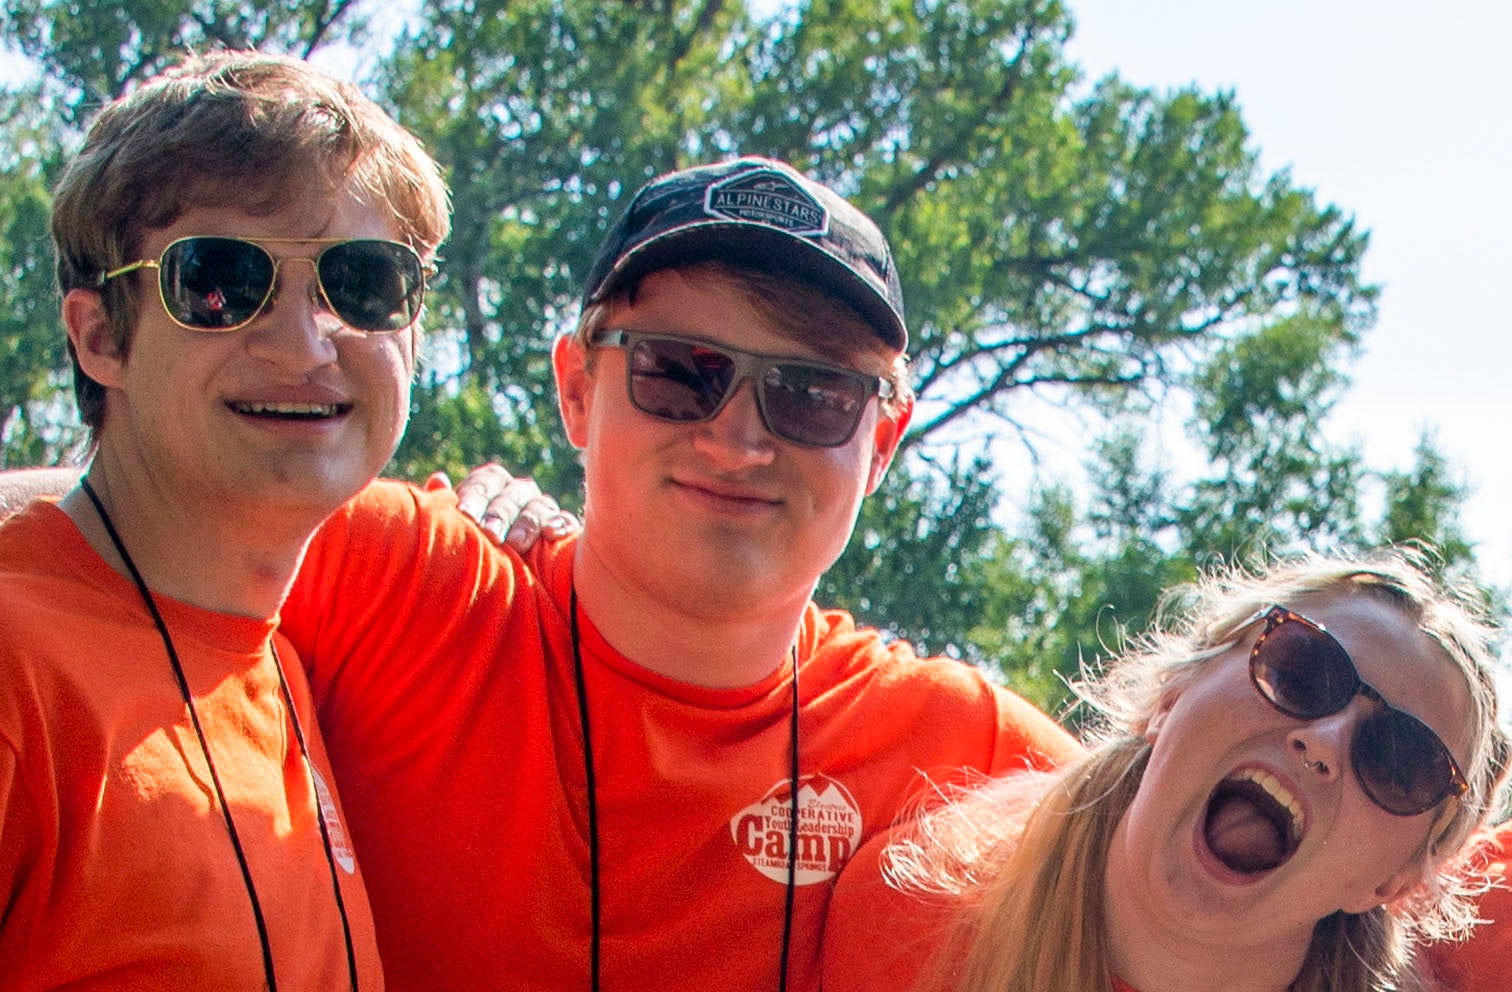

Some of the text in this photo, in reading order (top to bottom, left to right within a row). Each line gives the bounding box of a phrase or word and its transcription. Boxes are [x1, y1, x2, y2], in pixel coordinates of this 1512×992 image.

[716, 190, 820, 226] ALPINESTARS
[764, 816, 794, 831] Yout
[737, 814, 851, 872] Camp
